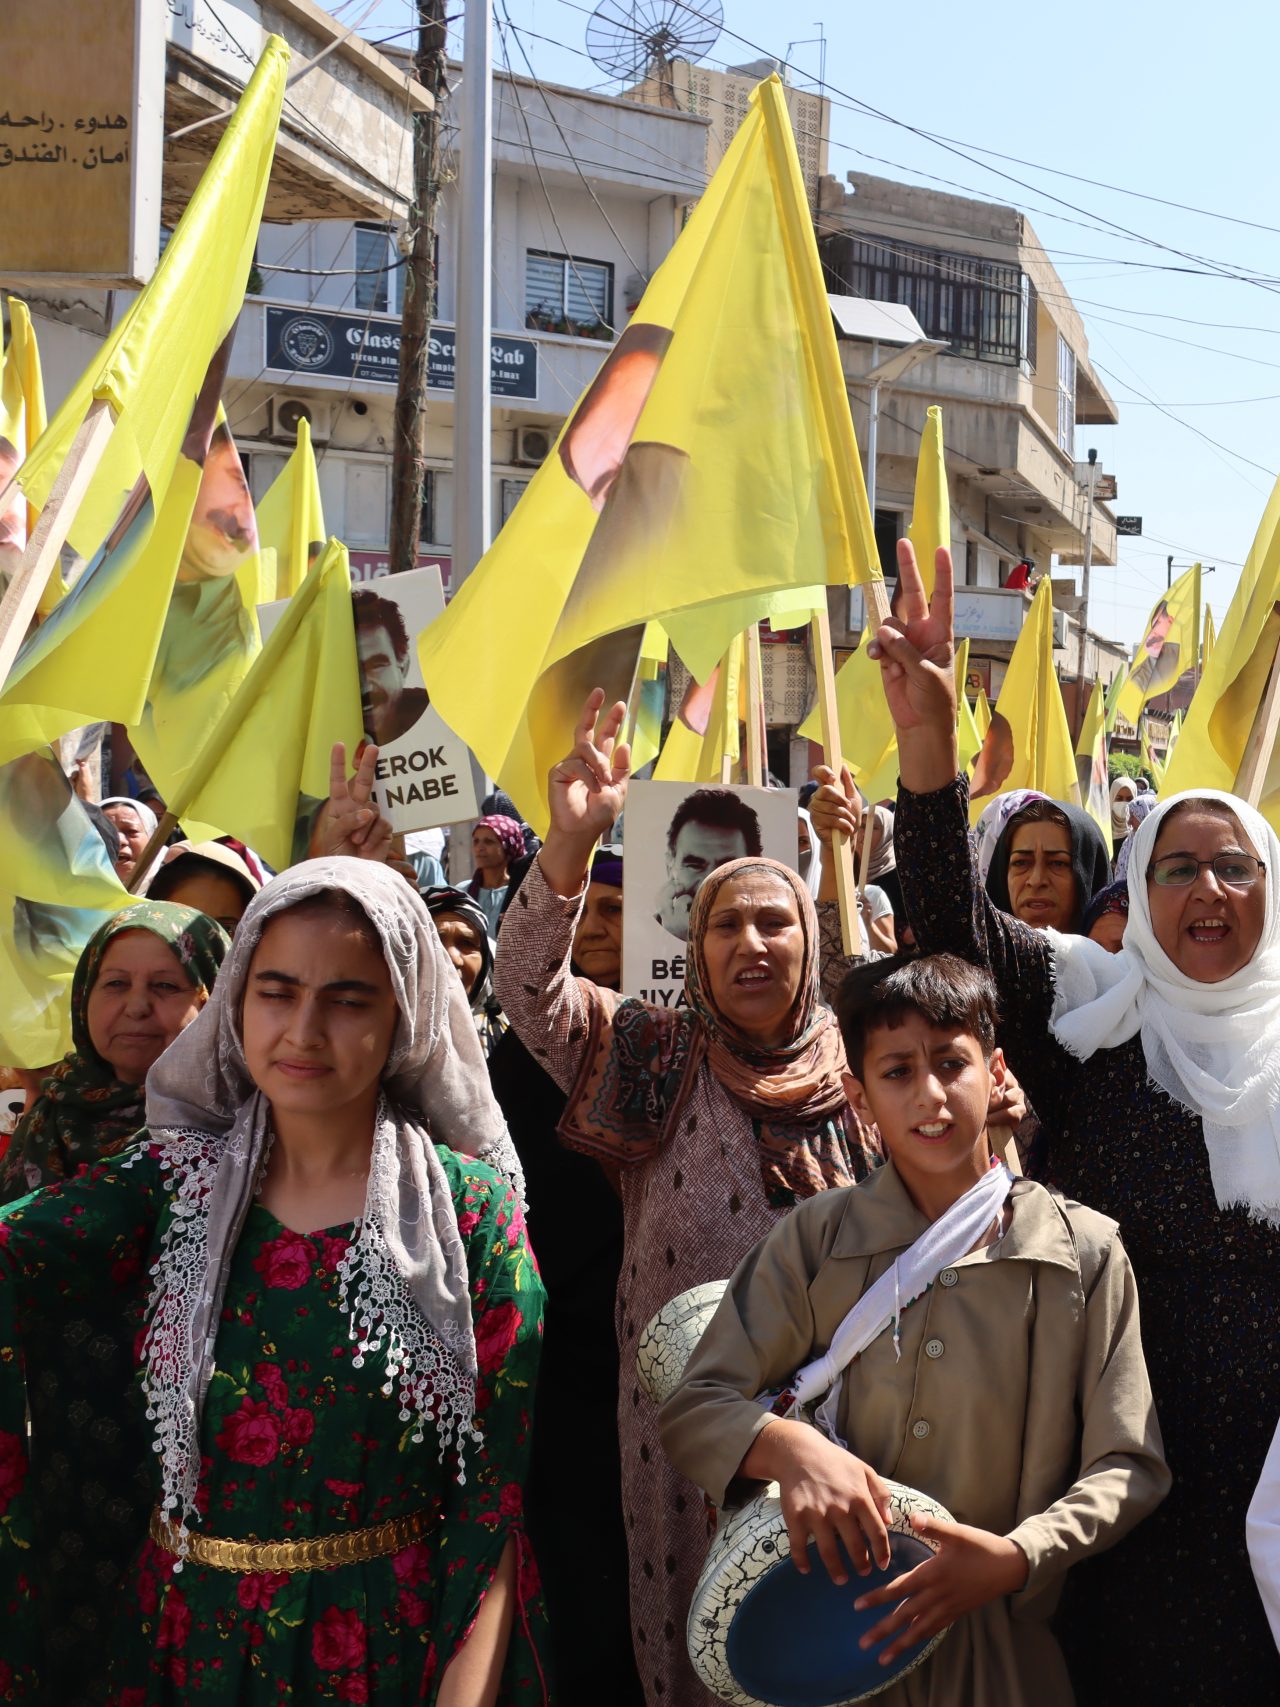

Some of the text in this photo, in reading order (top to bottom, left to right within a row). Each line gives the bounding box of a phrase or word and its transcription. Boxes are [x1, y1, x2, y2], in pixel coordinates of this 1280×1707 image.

[74, 114, 128, 134] هدوء
[82, 141, 129, 169] أمان
[491, 345, 525, 365] Lab
[375, 745, 448, 780] EROK
[385, 774, 459, 808] NABE
[651, 955, 687, 980] BÊ
